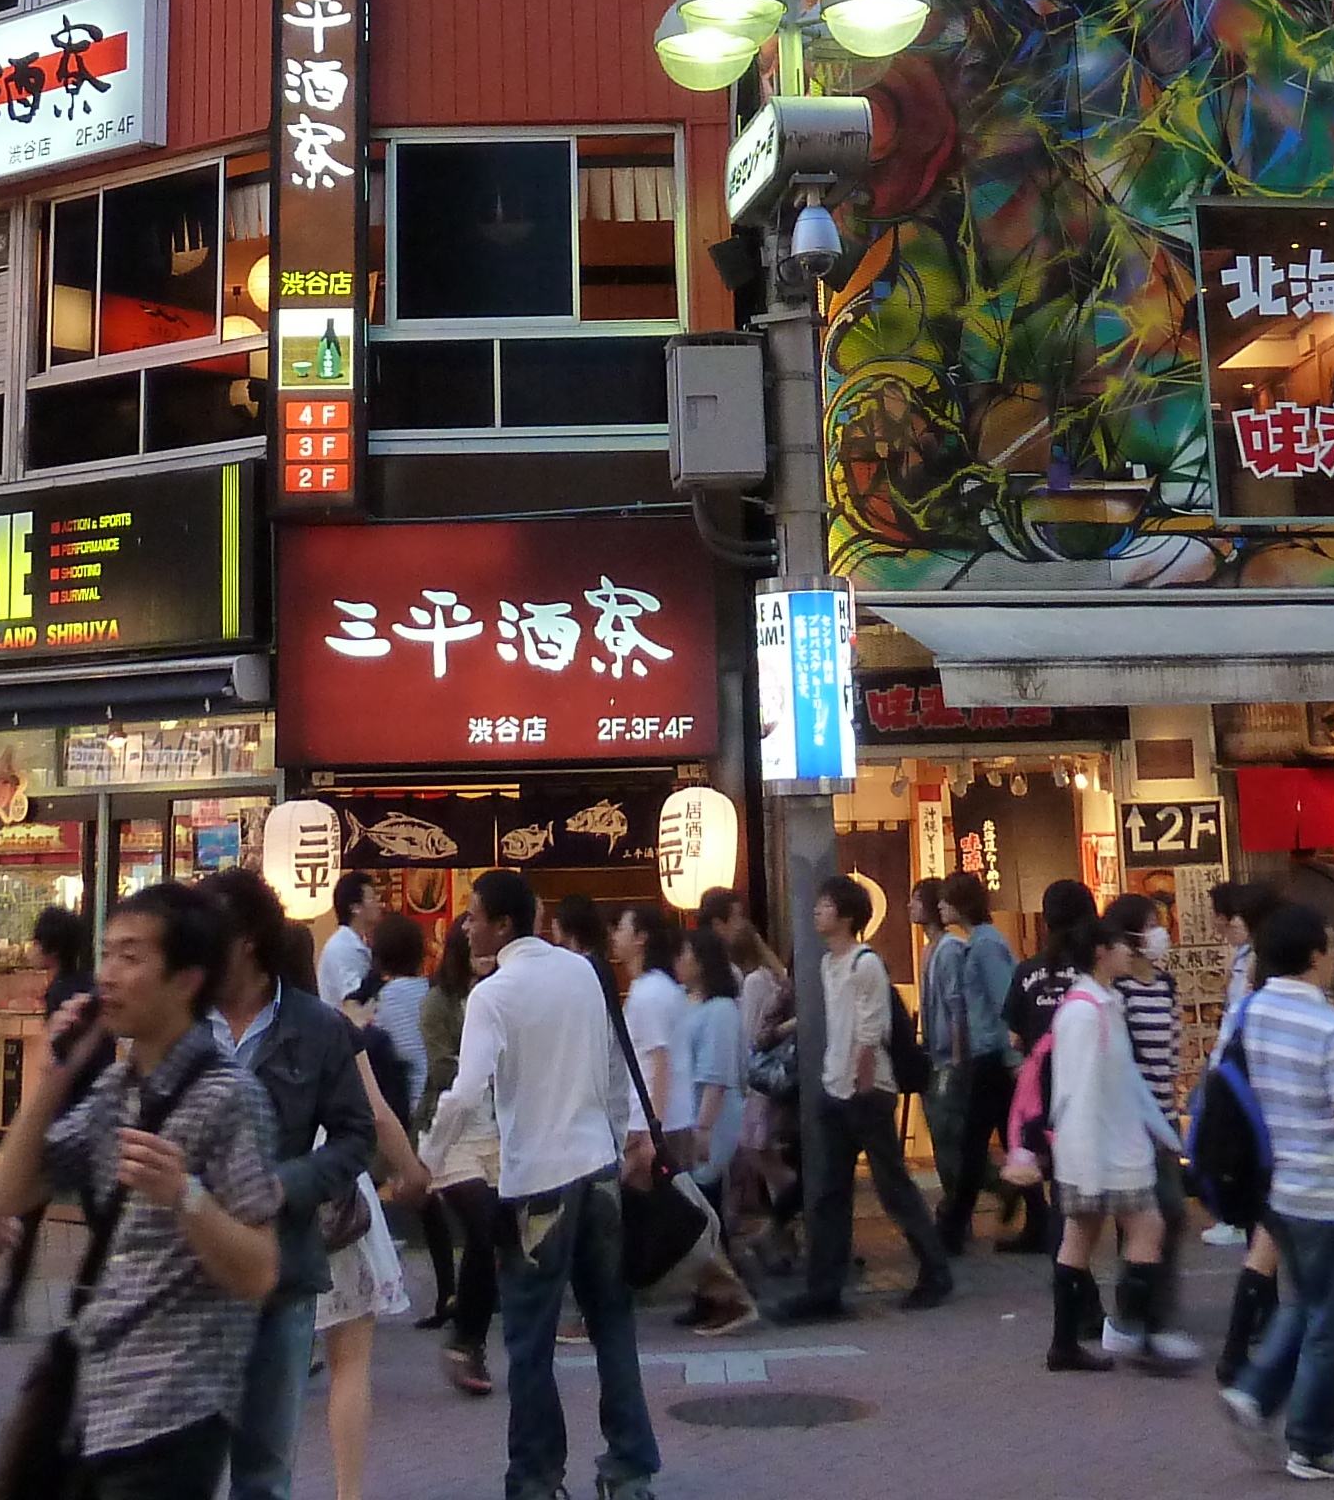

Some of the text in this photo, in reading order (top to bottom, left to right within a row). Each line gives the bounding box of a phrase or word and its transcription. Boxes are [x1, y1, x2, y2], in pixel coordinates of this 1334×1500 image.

[8, 137, 52, 165] 渋谷店
[280, 270, 353, 296] 渋谷店
[61, 517, 91, 533] ACTION
[99, 512, 132, 528] SPORTS
[60, 537, 120, 557] PERFORMANCE
[60, 562, 102, 580] SHOOTING
[60, 586, 102, 603] SURVIVAL
[46, 619, 120, 646] SHIBUYA
[324, 574, 674, 679] 三平酒寮
[467, 715, 694, 744] 渋谷店 2F.3F.4F
[685, 800, 702, 858] 居酒屋
[1155, 805, 1217, 851] 2F
[294, 823, 330, 898] 三平
[660, 811, 684, 888] 三平
